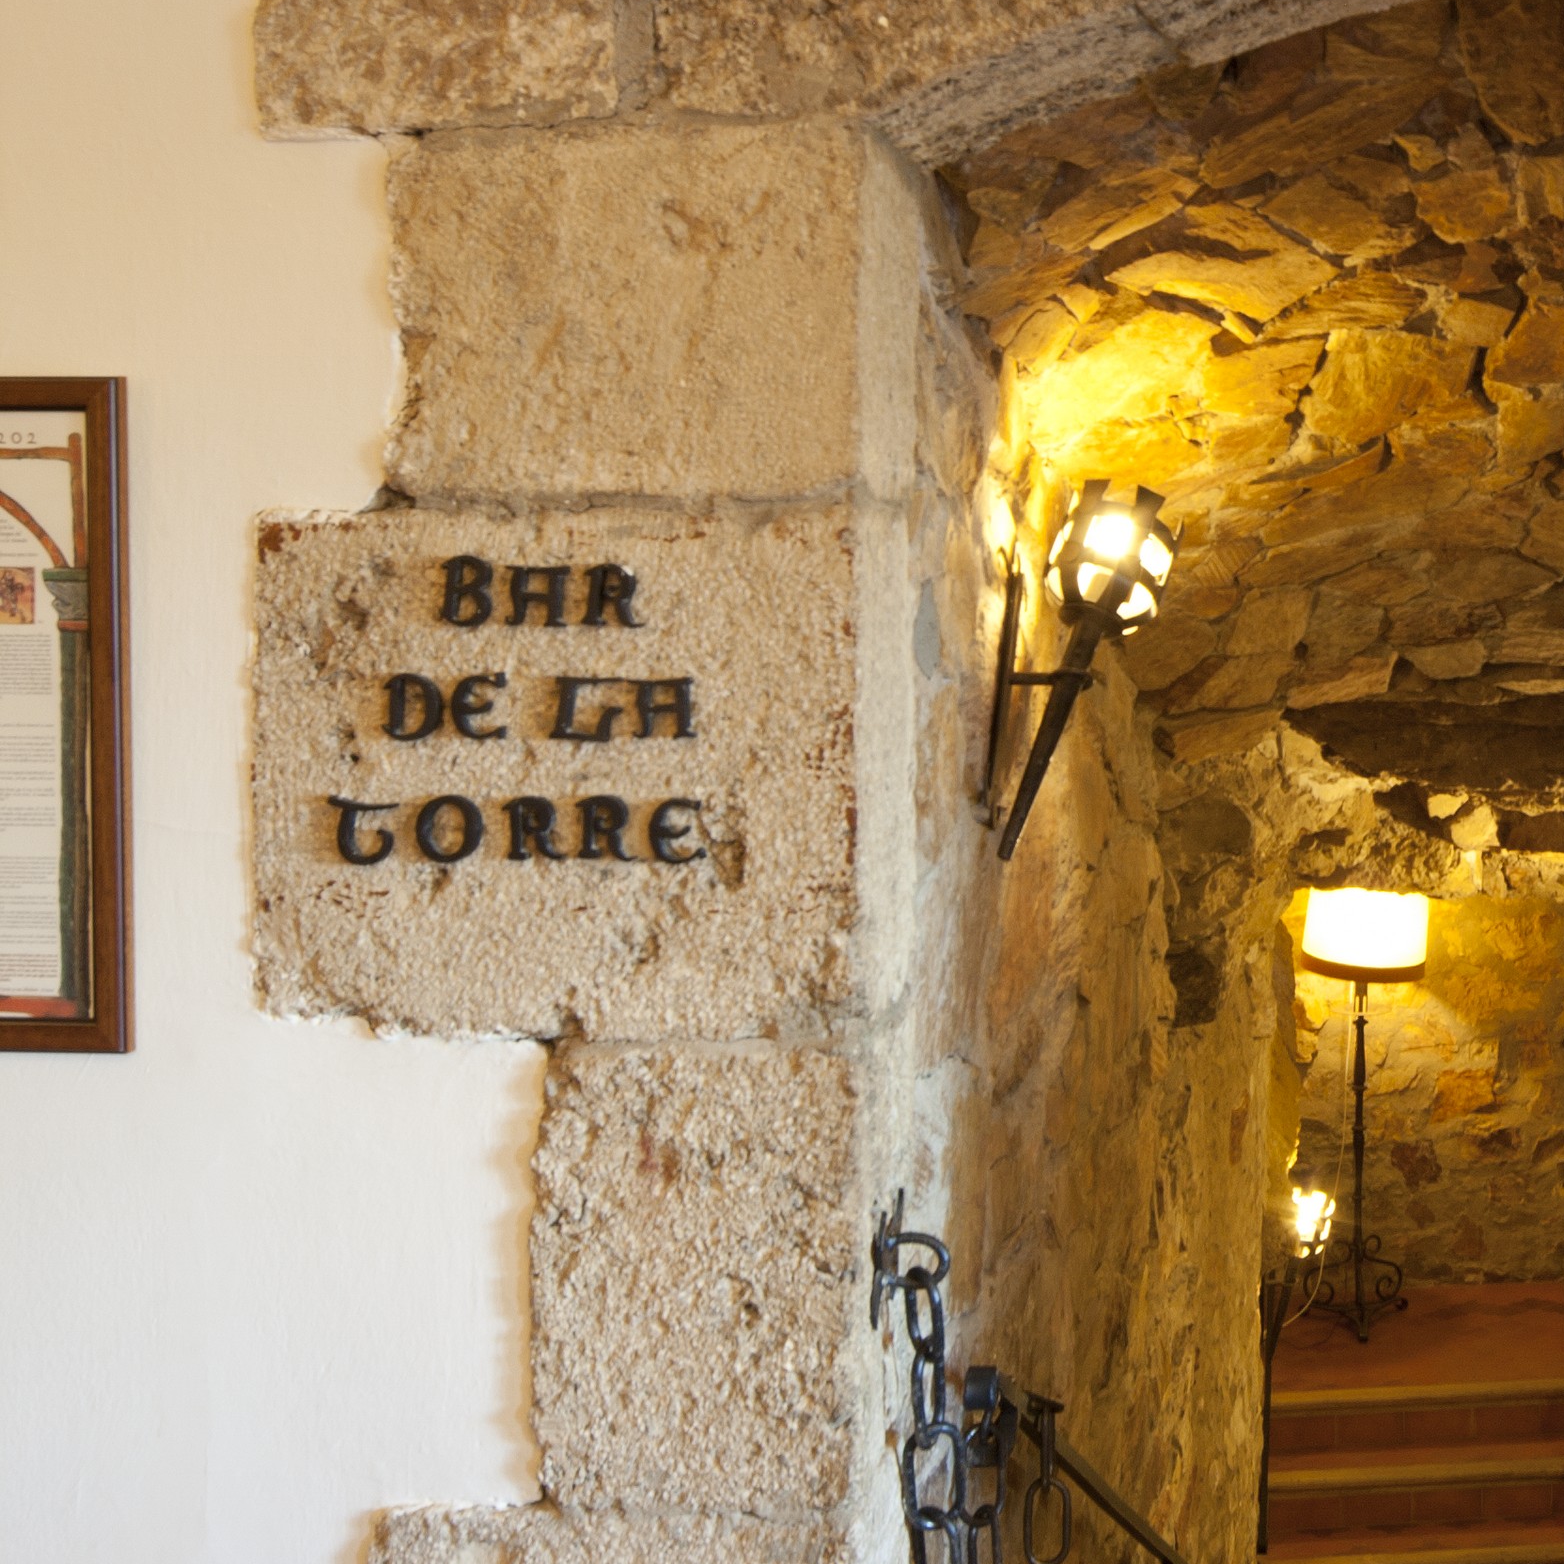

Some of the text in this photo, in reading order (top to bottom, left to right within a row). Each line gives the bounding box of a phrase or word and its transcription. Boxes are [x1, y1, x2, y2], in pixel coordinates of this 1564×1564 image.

[439, 555, 645, 628] BAR
[381, 672, 699, 742] DE LA
[327, 794, 707, 865] TORRE
